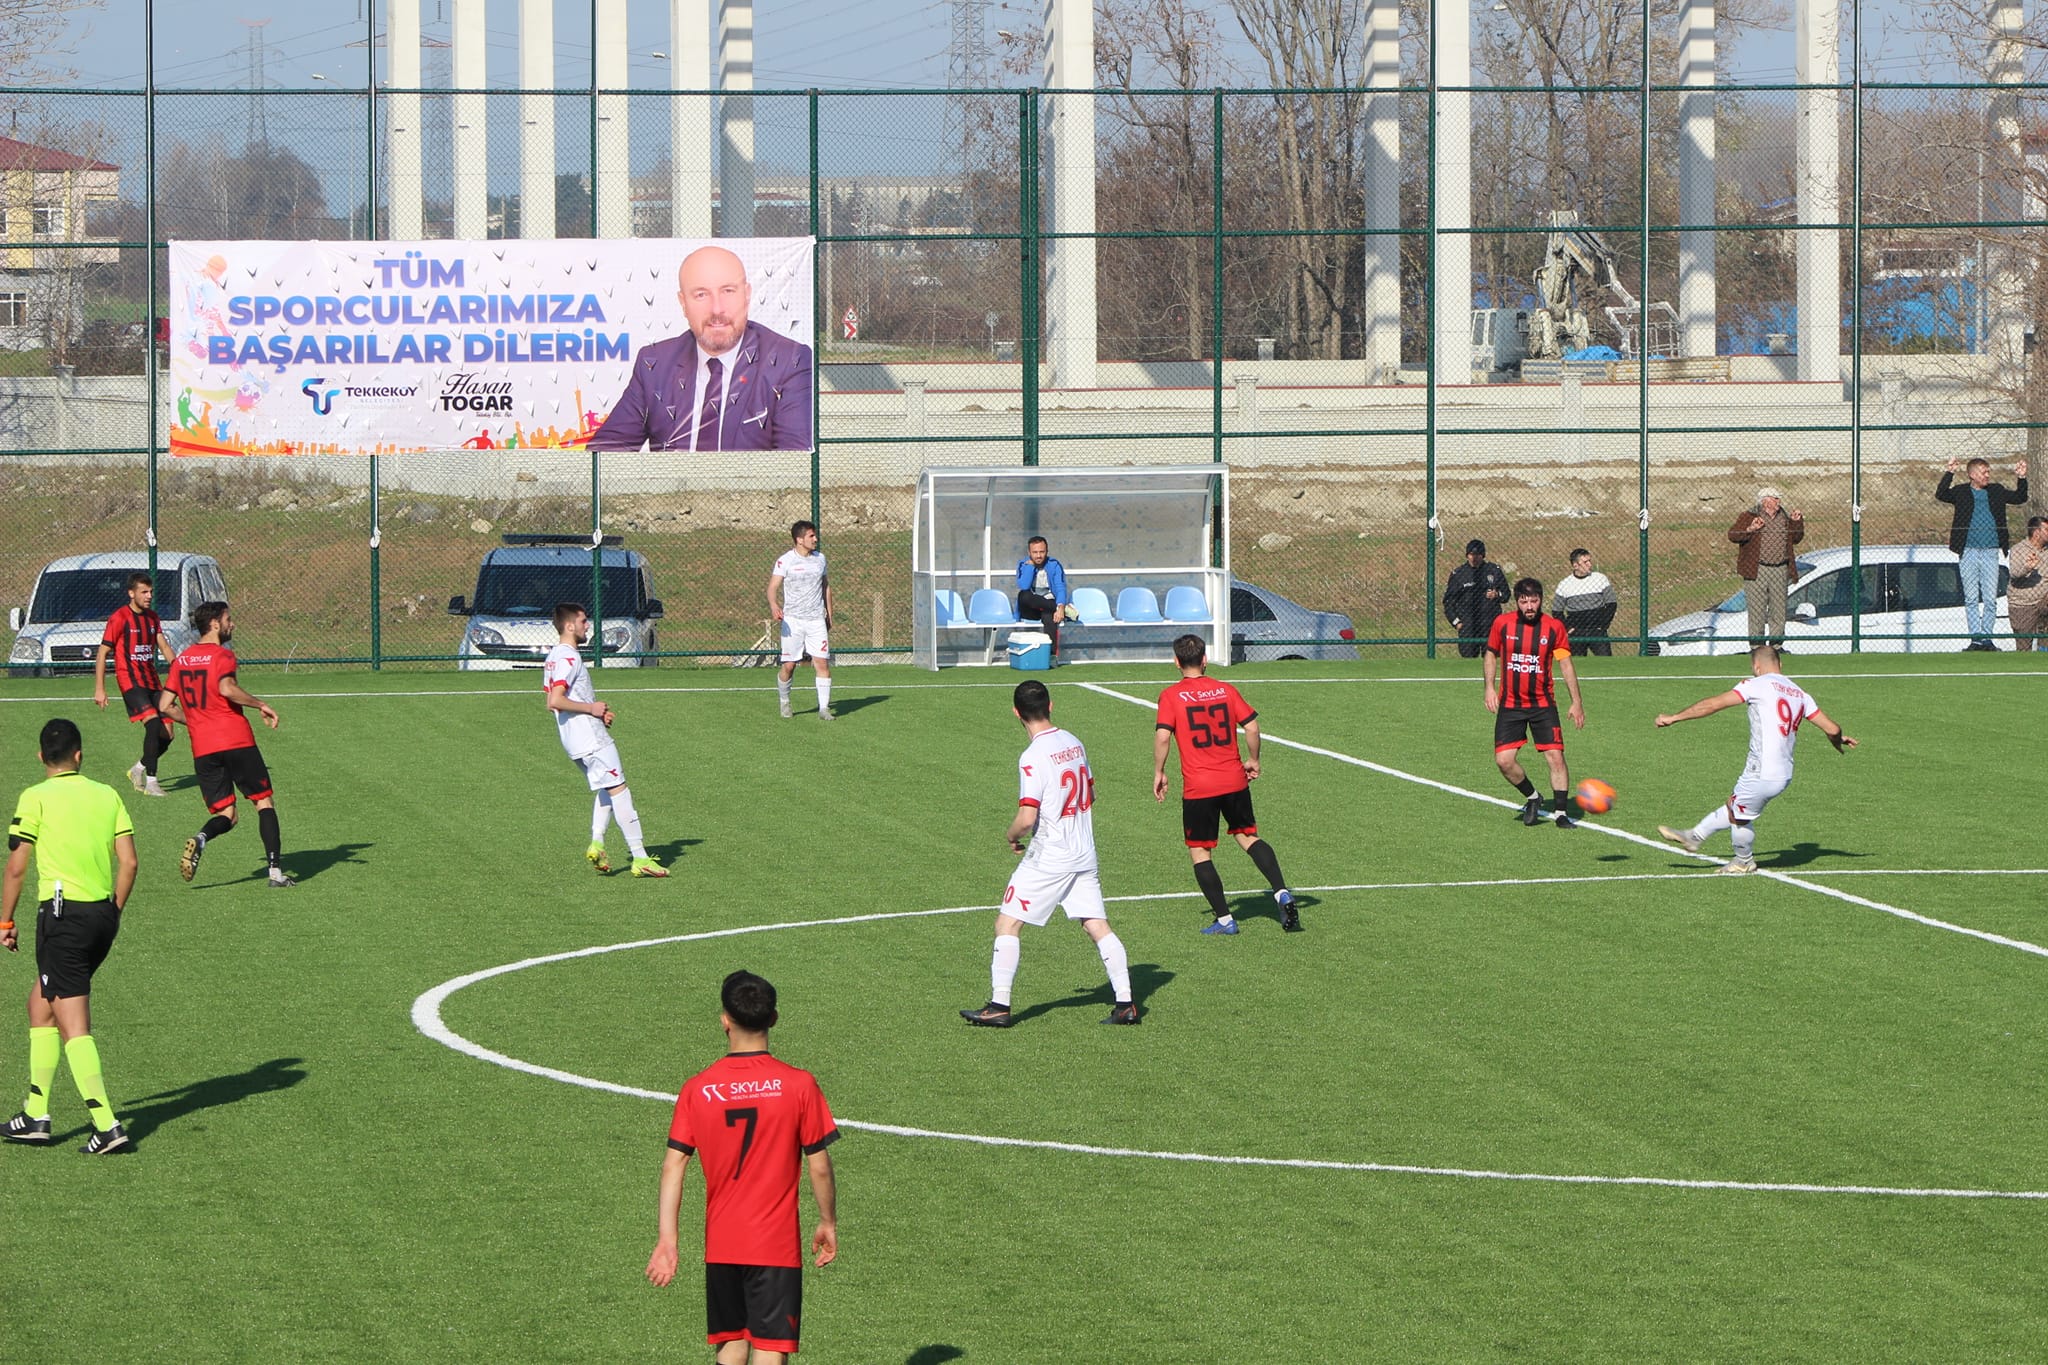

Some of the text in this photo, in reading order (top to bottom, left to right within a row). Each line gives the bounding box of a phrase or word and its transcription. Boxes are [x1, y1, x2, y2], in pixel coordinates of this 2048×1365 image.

[374, 250, 464, 289] TÜM
[228, 294, 606, 325] SPORCULARIMIZA
[207, 332, 452, 373] BAŞARILAR
[441, 372, 514, 395] Hasan
[440, 395, 513, 411] TOGAR
[1507, 662, 1543, 673] PROFİL
[1511, 653, 1540, 663] BERK
[179, 669, 208, 709] 67
[1197, 687, 1225, 698] SKYLAR
[1186, 703, 1231, 749] 53
[1060, 764, 1092, 818] 20
[730, 1079, 782, 1094] SKYLAR
[724, 1107, 758, 1180] 7
